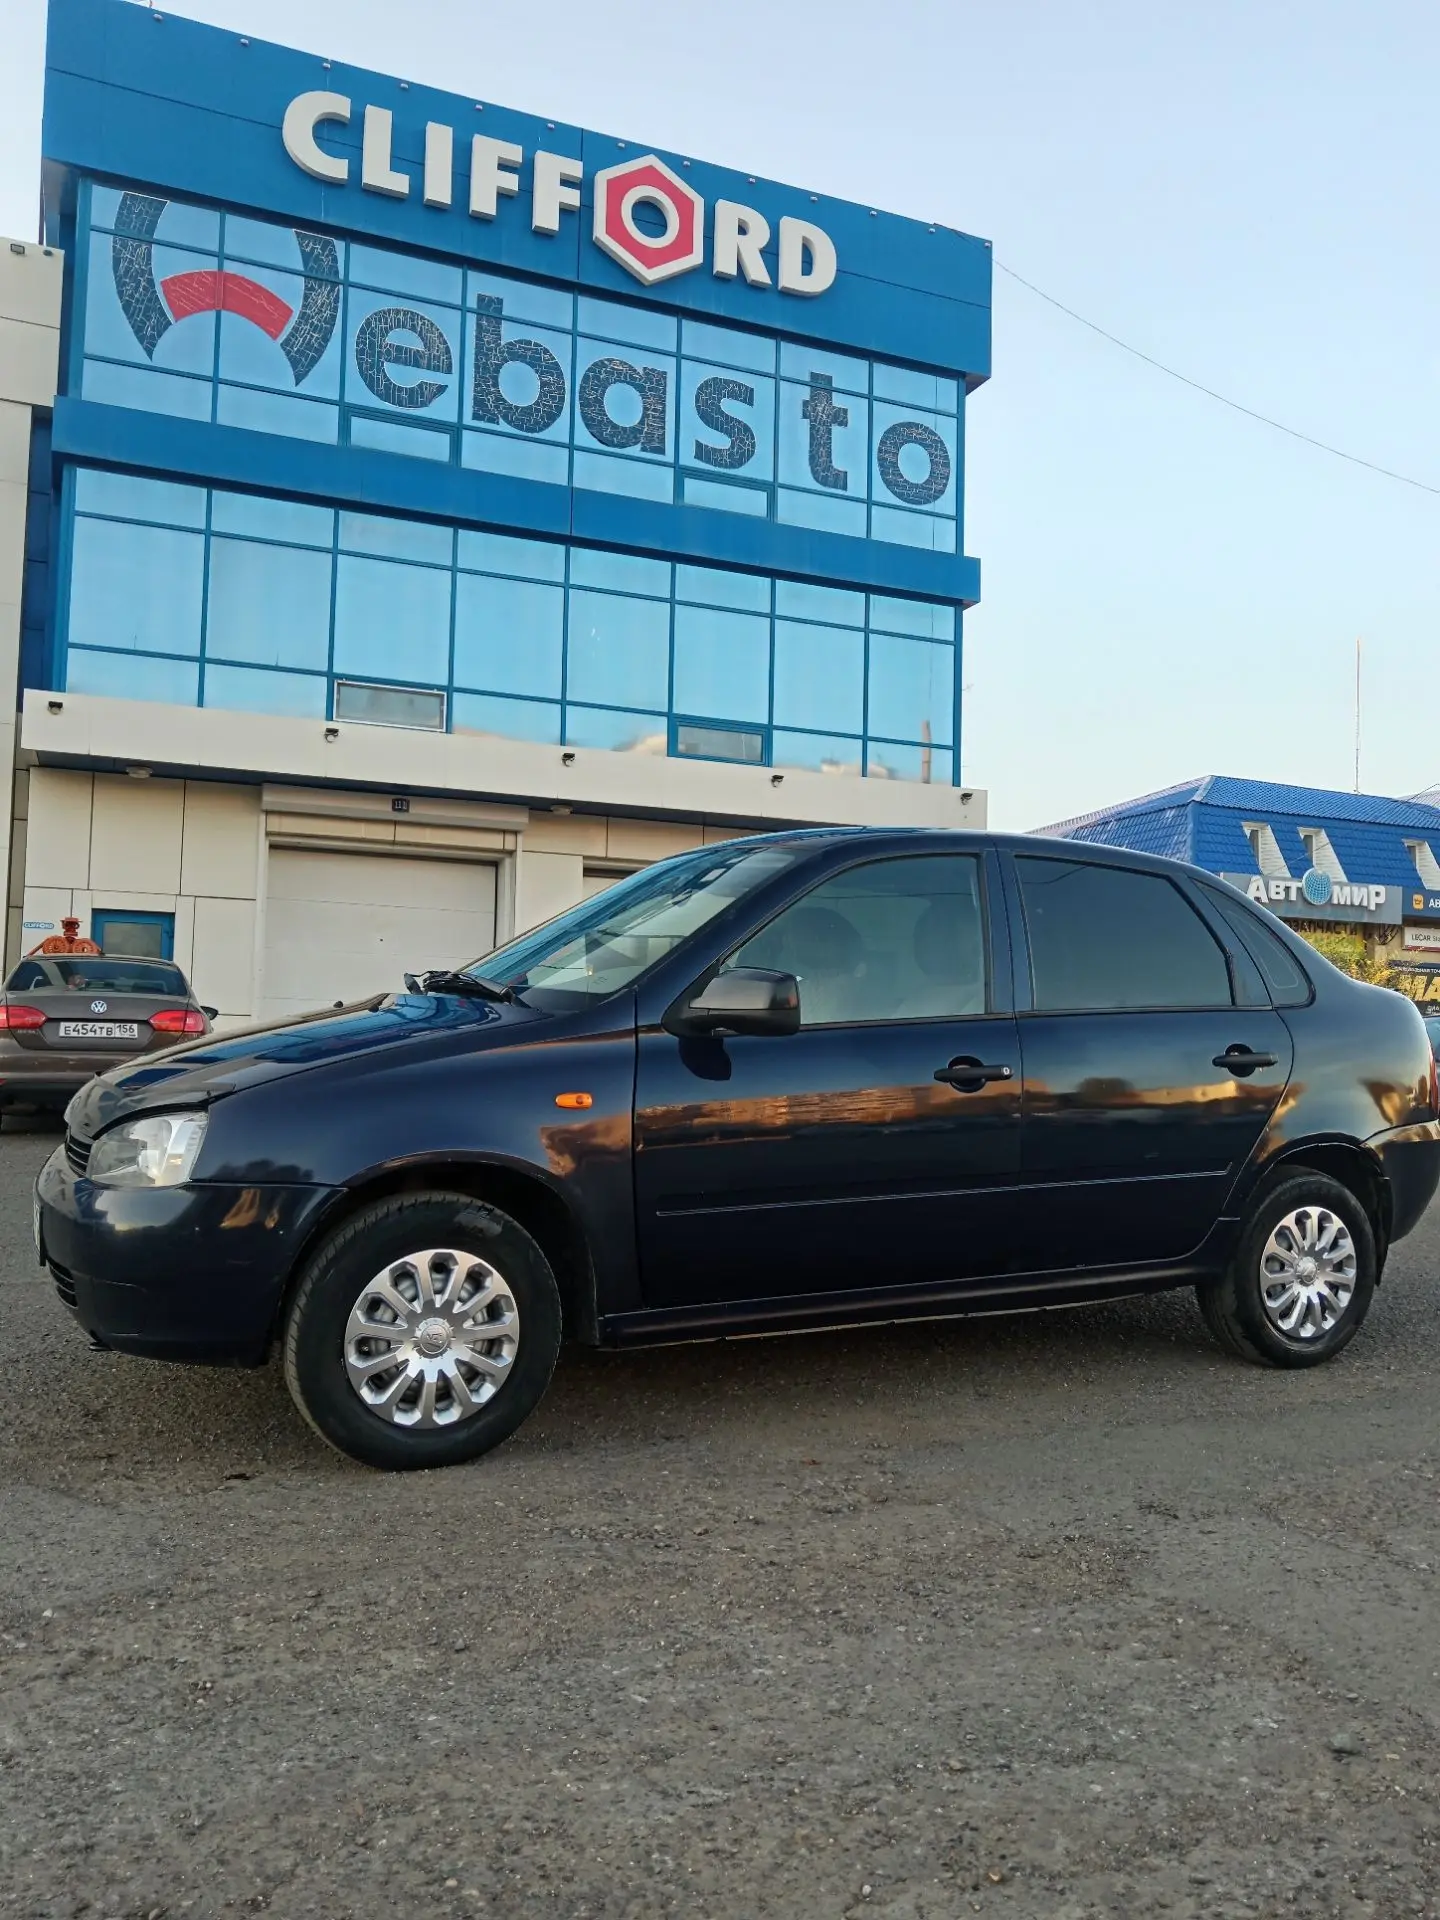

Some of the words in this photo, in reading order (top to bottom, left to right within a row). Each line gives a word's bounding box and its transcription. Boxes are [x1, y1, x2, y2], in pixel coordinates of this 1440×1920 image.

[282, 91, 837, 297] CLIFFORD
[112, 191, 952, 506] Webasto
[117, 1025, 135, 1034] 156
